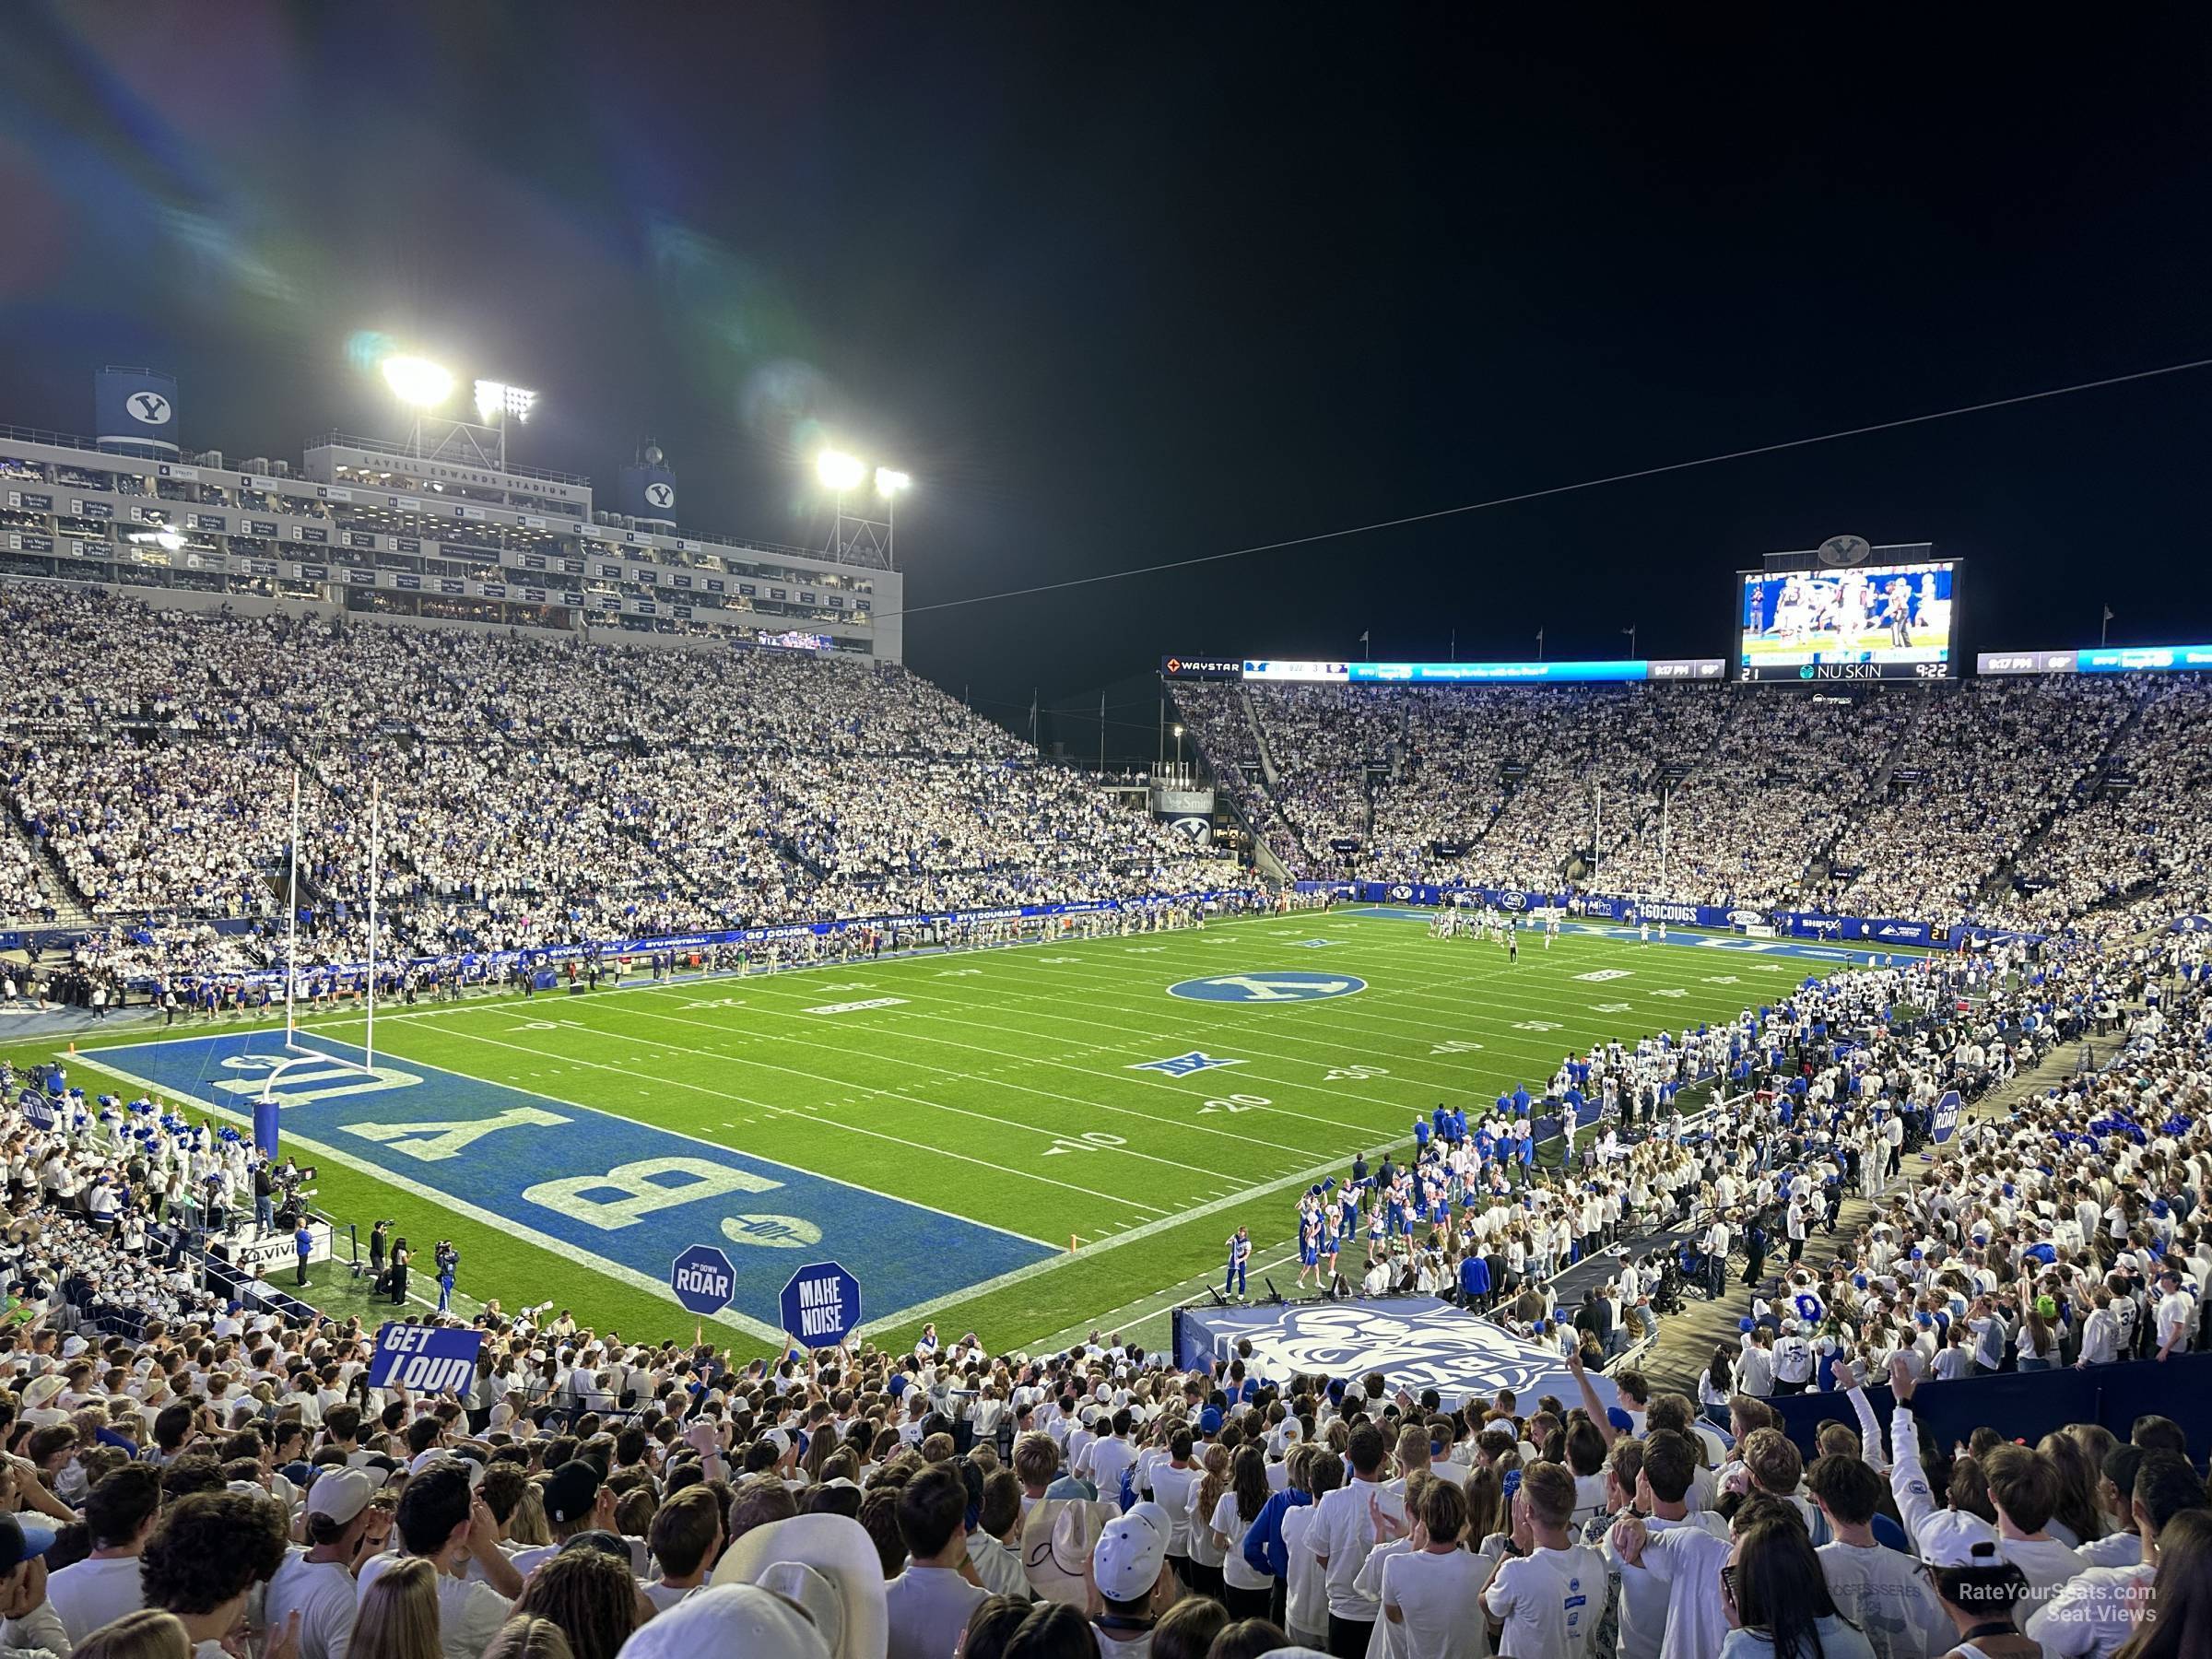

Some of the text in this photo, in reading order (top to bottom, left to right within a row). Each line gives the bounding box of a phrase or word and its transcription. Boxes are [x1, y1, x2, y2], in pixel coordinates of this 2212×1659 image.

[135, 394, 164, 421] Y
[364, 456, 568, 497] LAVELL EDWARDS STADIUM
[651, 485, 671, 506] Y
[1182, 661, 1240, 672] WAYSTAR
[2012, 657, 2031, 668] PM
[1674, 664, 1689, 676] PM
[1742, 667, 1759, 680] 21
[1818, 664, 1881, 678] NU SKIN
[1916, 665, 1947, 677] 9:22
[957, 908, 1022, 922] BYU COUGARS
[1640, 903, 1697, 922] #GOCOUGS
[869, 917, 924, 929] FOTBALL
[1802, 918, 1841, 932] SHIPEX
[747, 927, 809, 939] GO COUGS
[1931, 929, 1947, 940] 21
[665, 936, 707, 947] FOOTBALL
[1327, 1065, 1390, 1079] 30
[1203, 1094, 1272, 1113] 20
[1935, 1110, 1959, 1130] ROAR
[212, 1065, 784, 1231] BYU
[1052, 1132, 1127, 1151] 10
[703, 1264, 718, 1274] DOWN
[677, 1269, 728, 1298] ROAR
[799, 1276, 841, 1307] MAKE
[801, 1303, 845, 1336] NOISE
[383, 1326, 436, 1353] GET
[388, 1354, 475, 1393] LOUD
